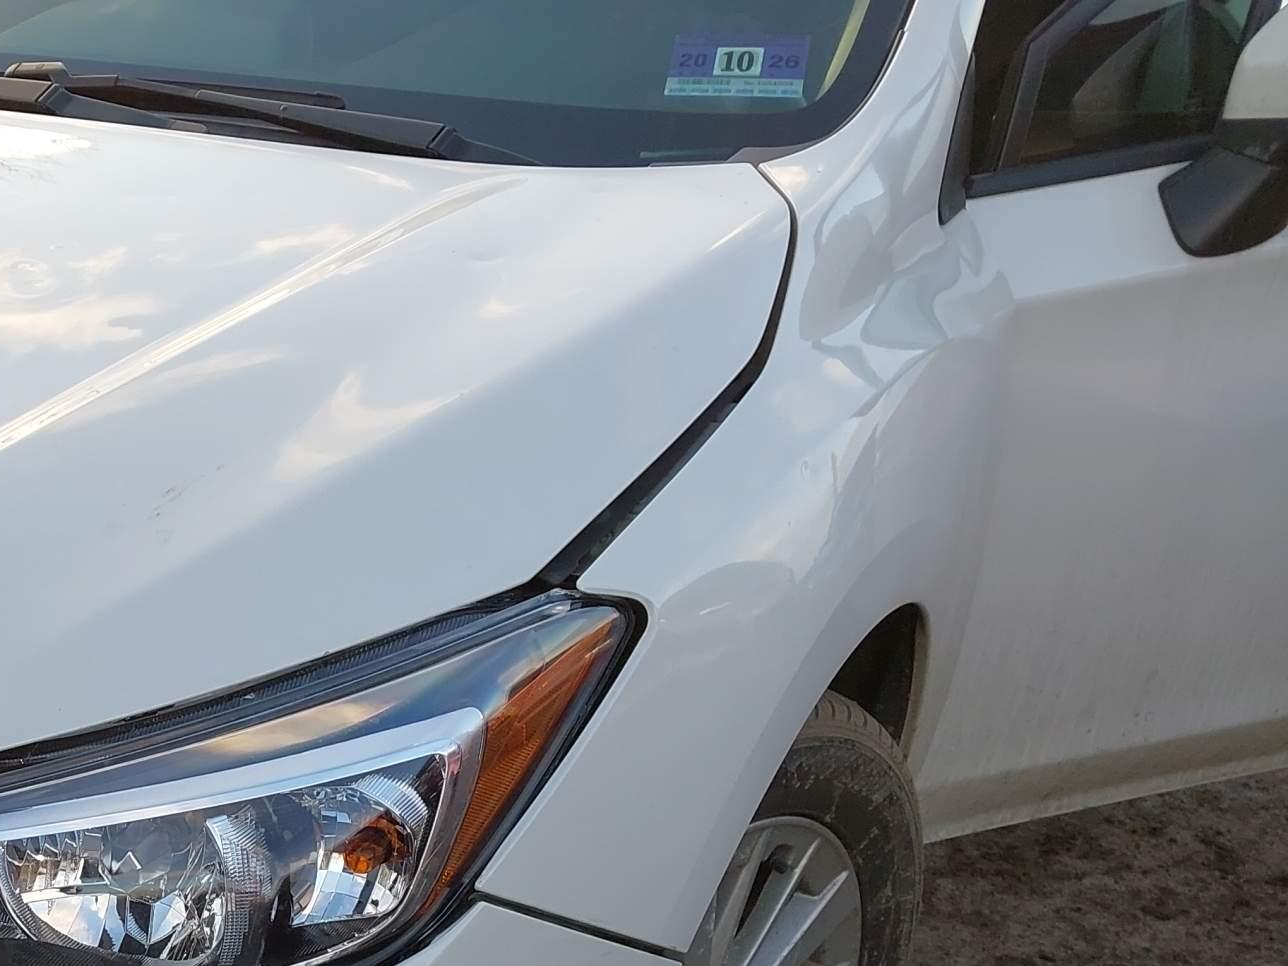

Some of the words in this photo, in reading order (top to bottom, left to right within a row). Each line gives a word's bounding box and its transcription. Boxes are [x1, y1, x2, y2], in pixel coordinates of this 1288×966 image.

[679, 53, 708, 68] 20
[720, 51, 755, 72] 10
[769, 55, 800, 69] 26
